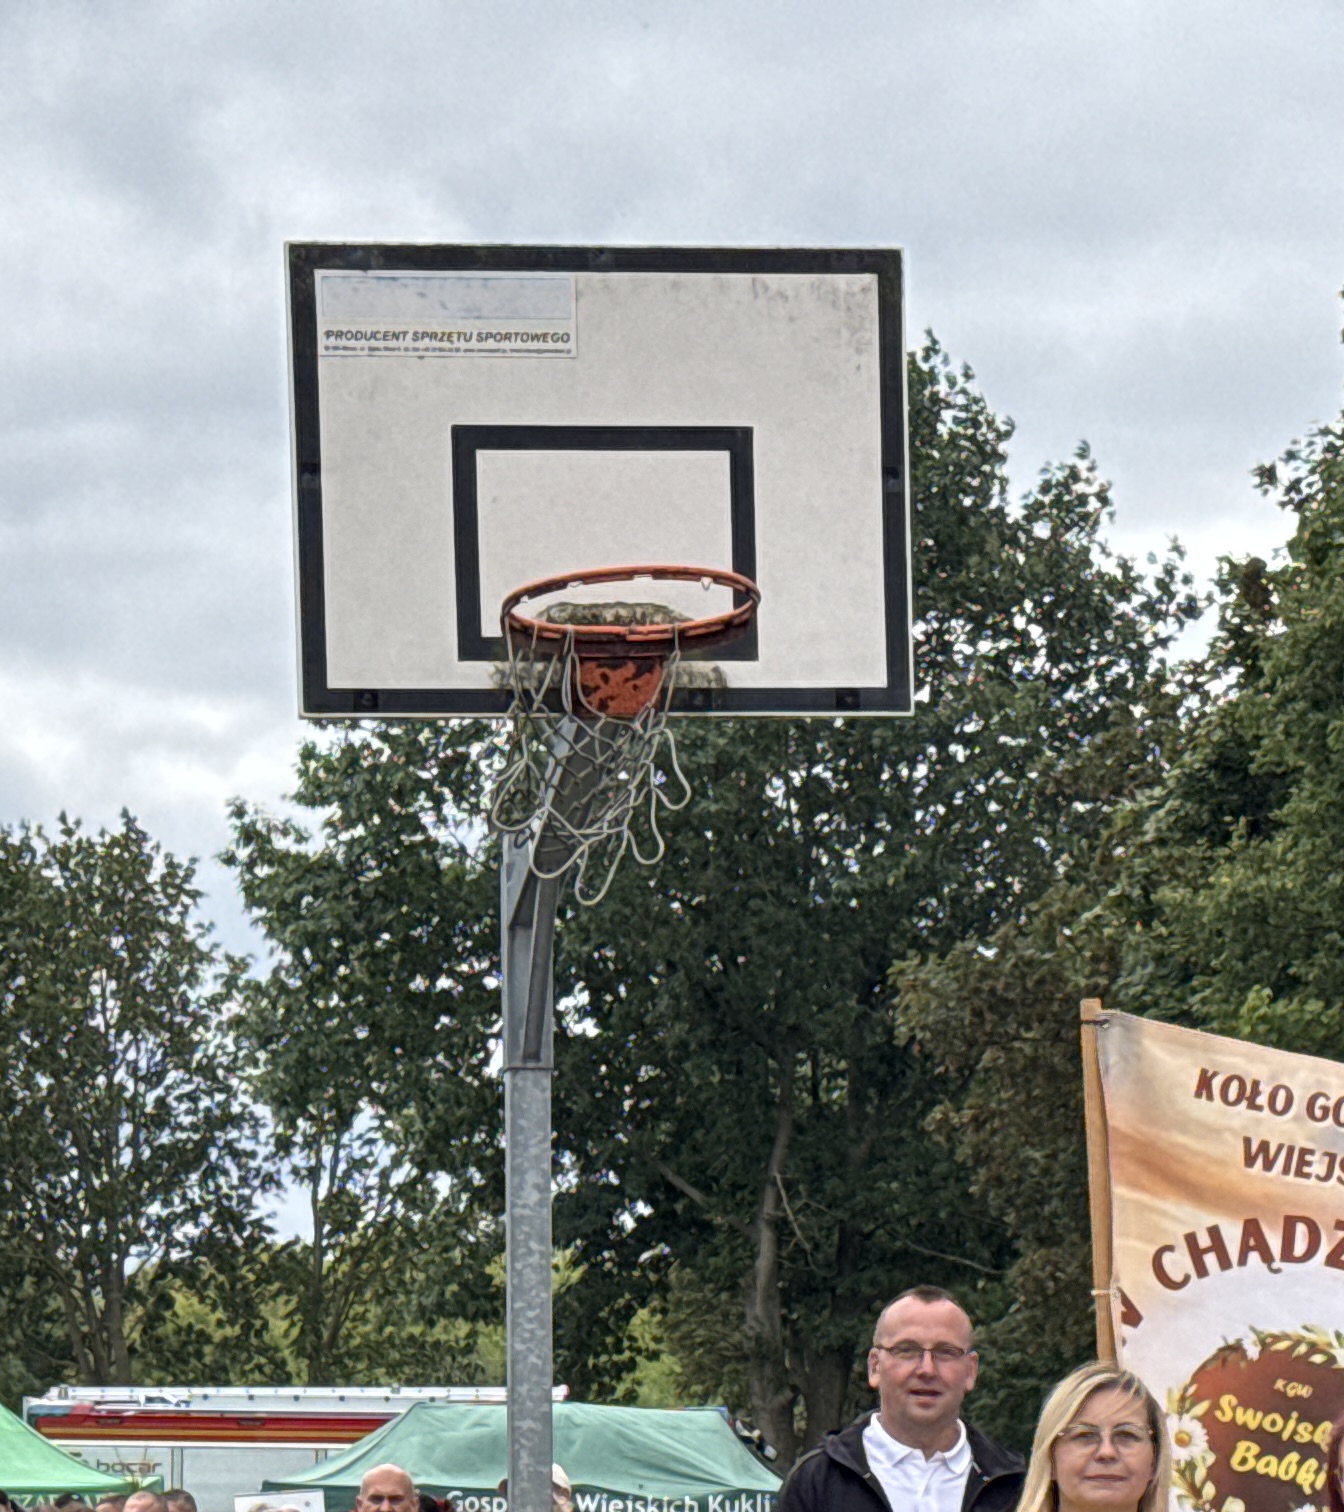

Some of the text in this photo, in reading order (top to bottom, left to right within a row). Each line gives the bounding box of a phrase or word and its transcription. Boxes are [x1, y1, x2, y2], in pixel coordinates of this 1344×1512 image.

[324, 330, 571, 345] PRODUCENT SPRZĘTU SPORTOWEGO
[1195, 1067, 1294, 1117] KOŁO
[1273, 1378, 1313, 1399] KGW
[1214, 1394, 1334, 1453] Swojsk
[96, 1458, 163, 1474] bocar
[1230, 1440, 1328, 1495] Babki
